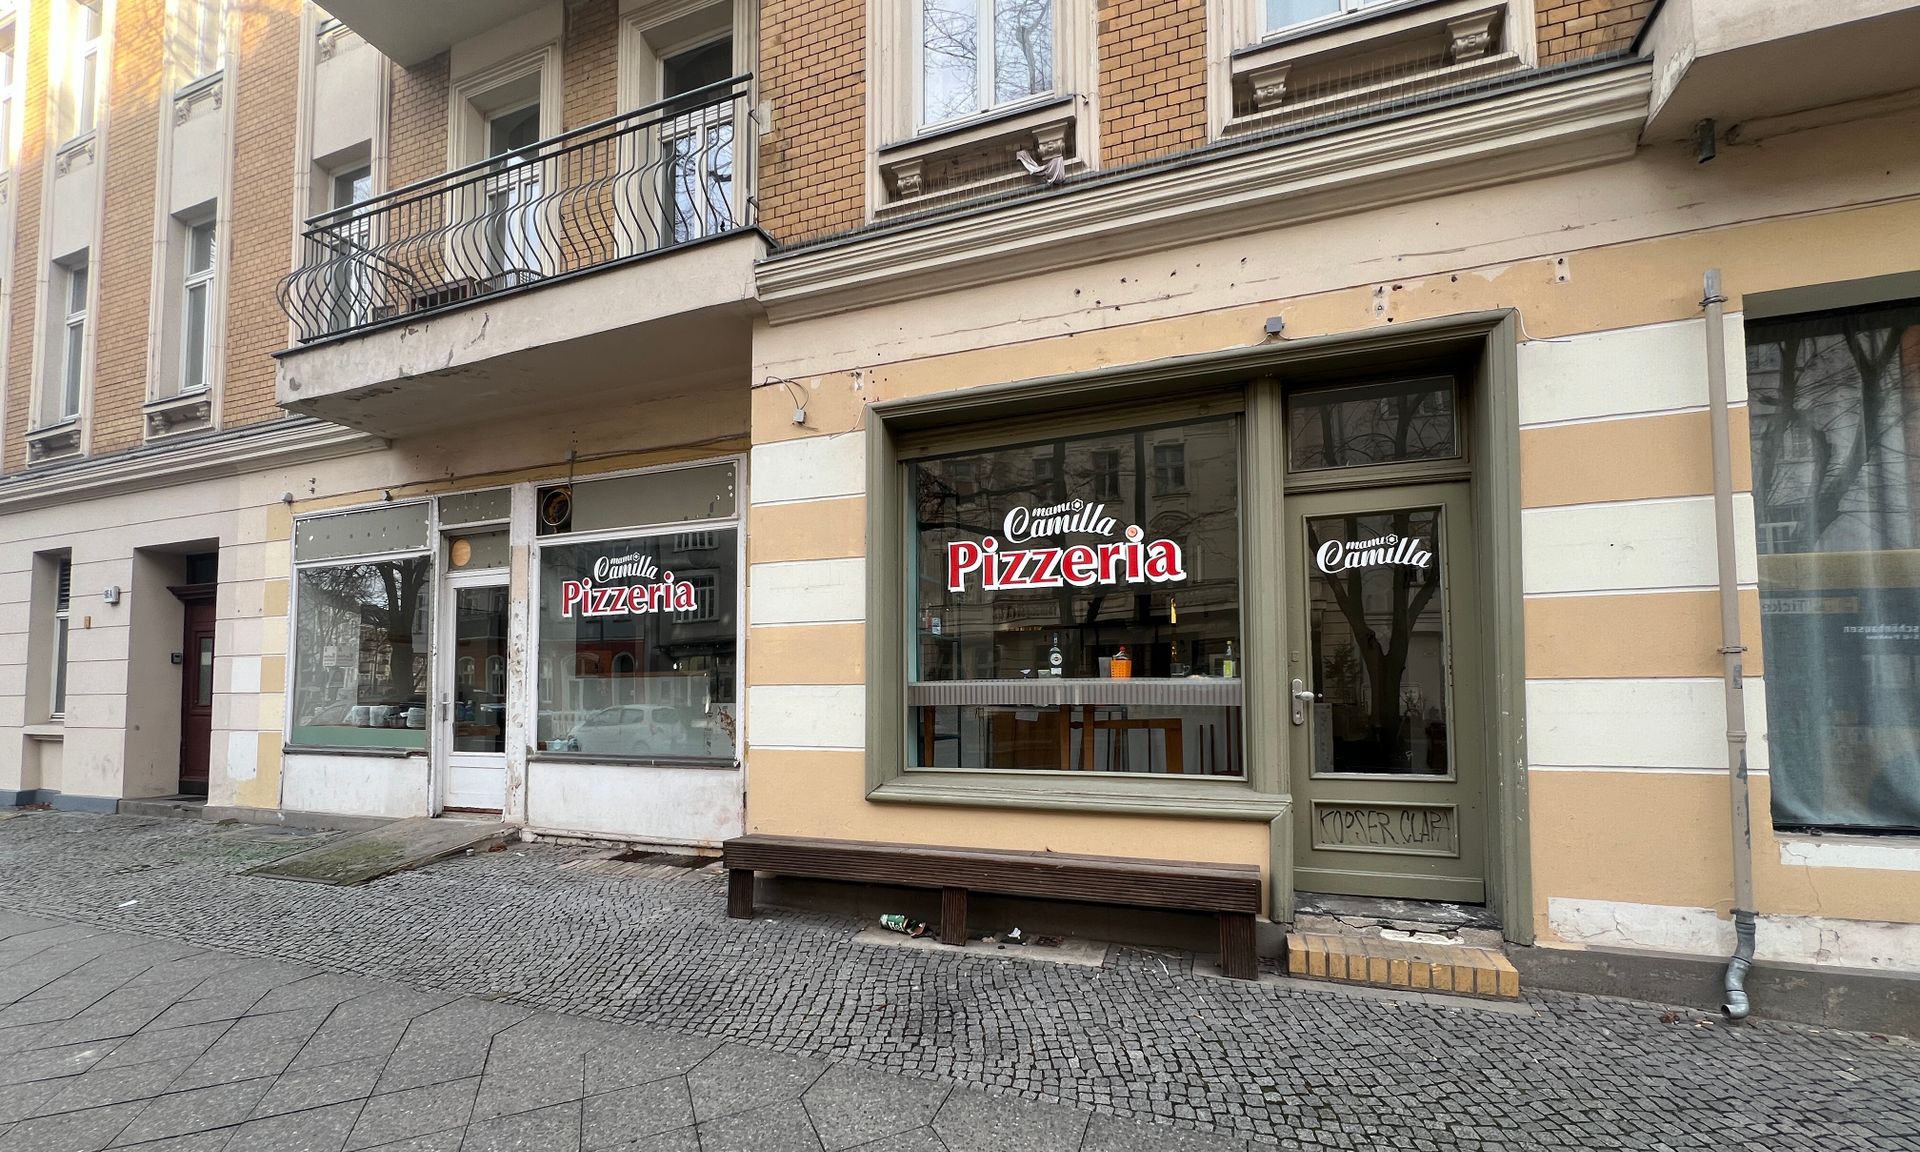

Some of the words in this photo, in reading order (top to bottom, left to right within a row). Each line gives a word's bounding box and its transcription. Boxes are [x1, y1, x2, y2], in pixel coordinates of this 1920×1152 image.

[1003, 502, 1117, 543] Camilla
[593, 555, 658, 583] Camilla
[948, 525, 1187, 592] Pizzeria
[1316, 537, 1432, 573] Camilla
[562, 571, 697, 617] Pizzeria
